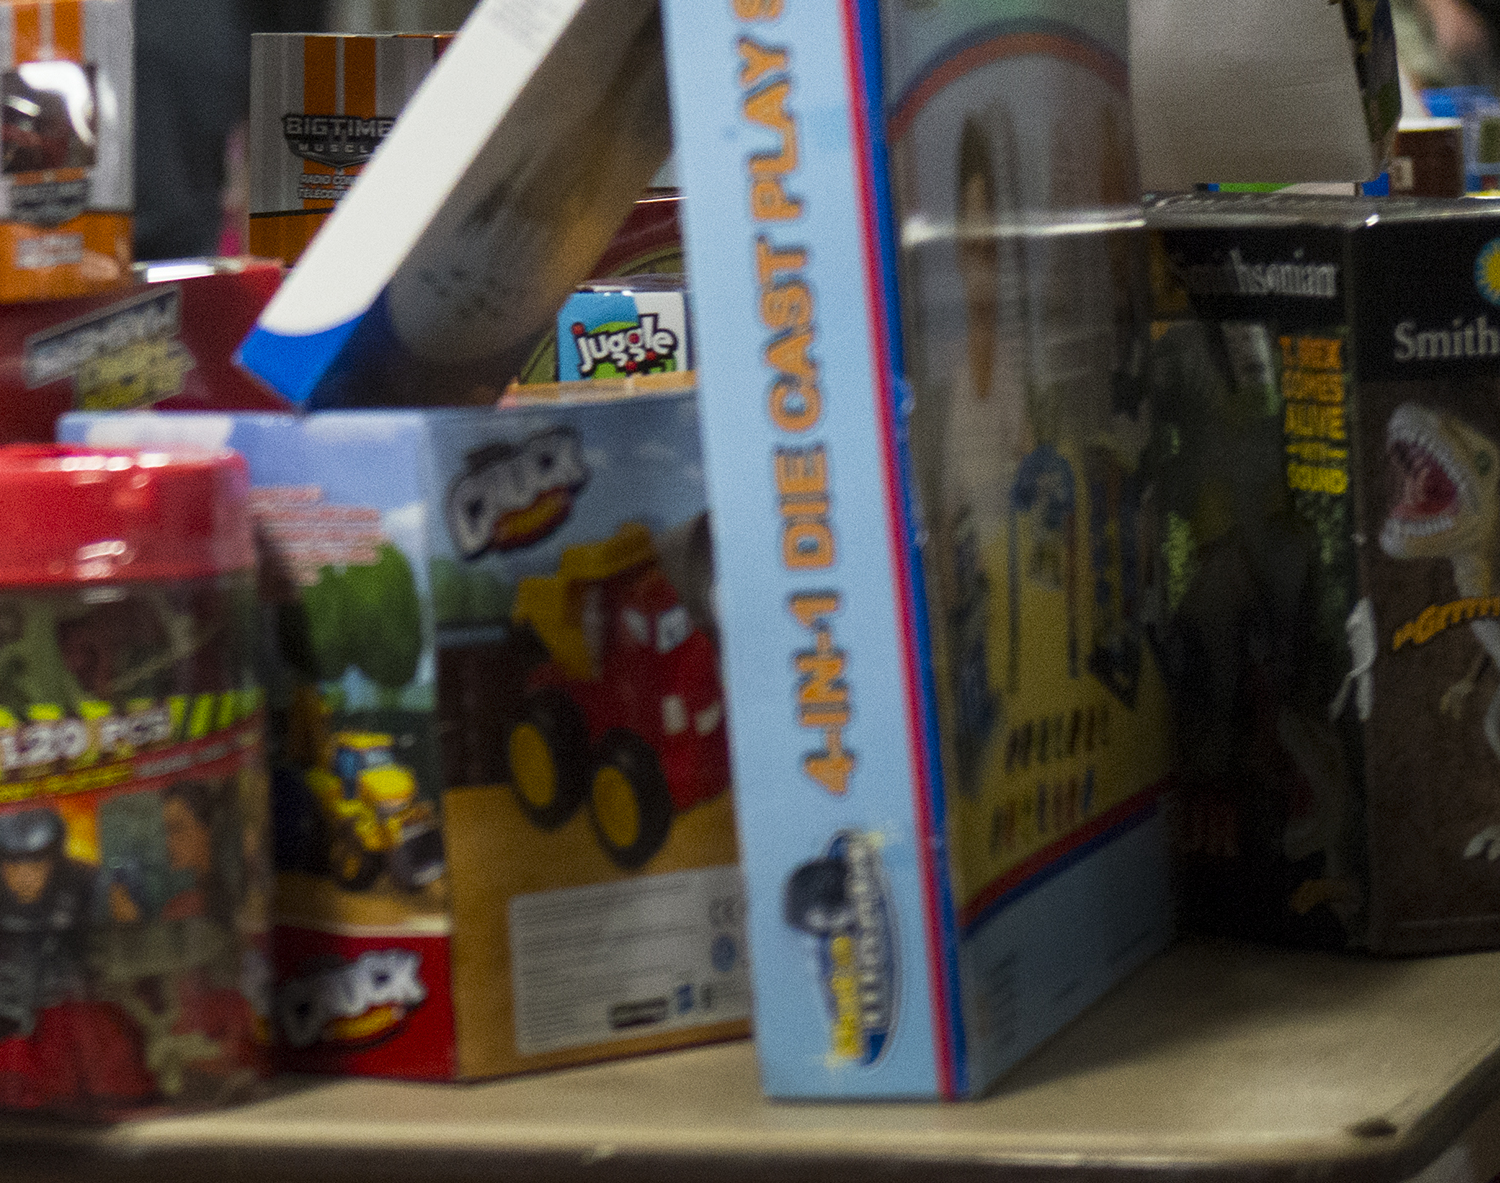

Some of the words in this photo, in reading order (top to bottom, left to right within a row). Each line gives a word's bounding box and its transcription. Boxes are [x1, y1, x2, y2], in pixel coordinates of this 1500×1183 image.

[737, 37, 804, 222] PLAY
[571, 312, 678, 374] juggle
[755, 236, 823, 432] CAST
[1394, 316, 1500, 361] Smith
[773, 444, 837, 570] DIE
[788, 591, 856, 795] 4-IN-1
